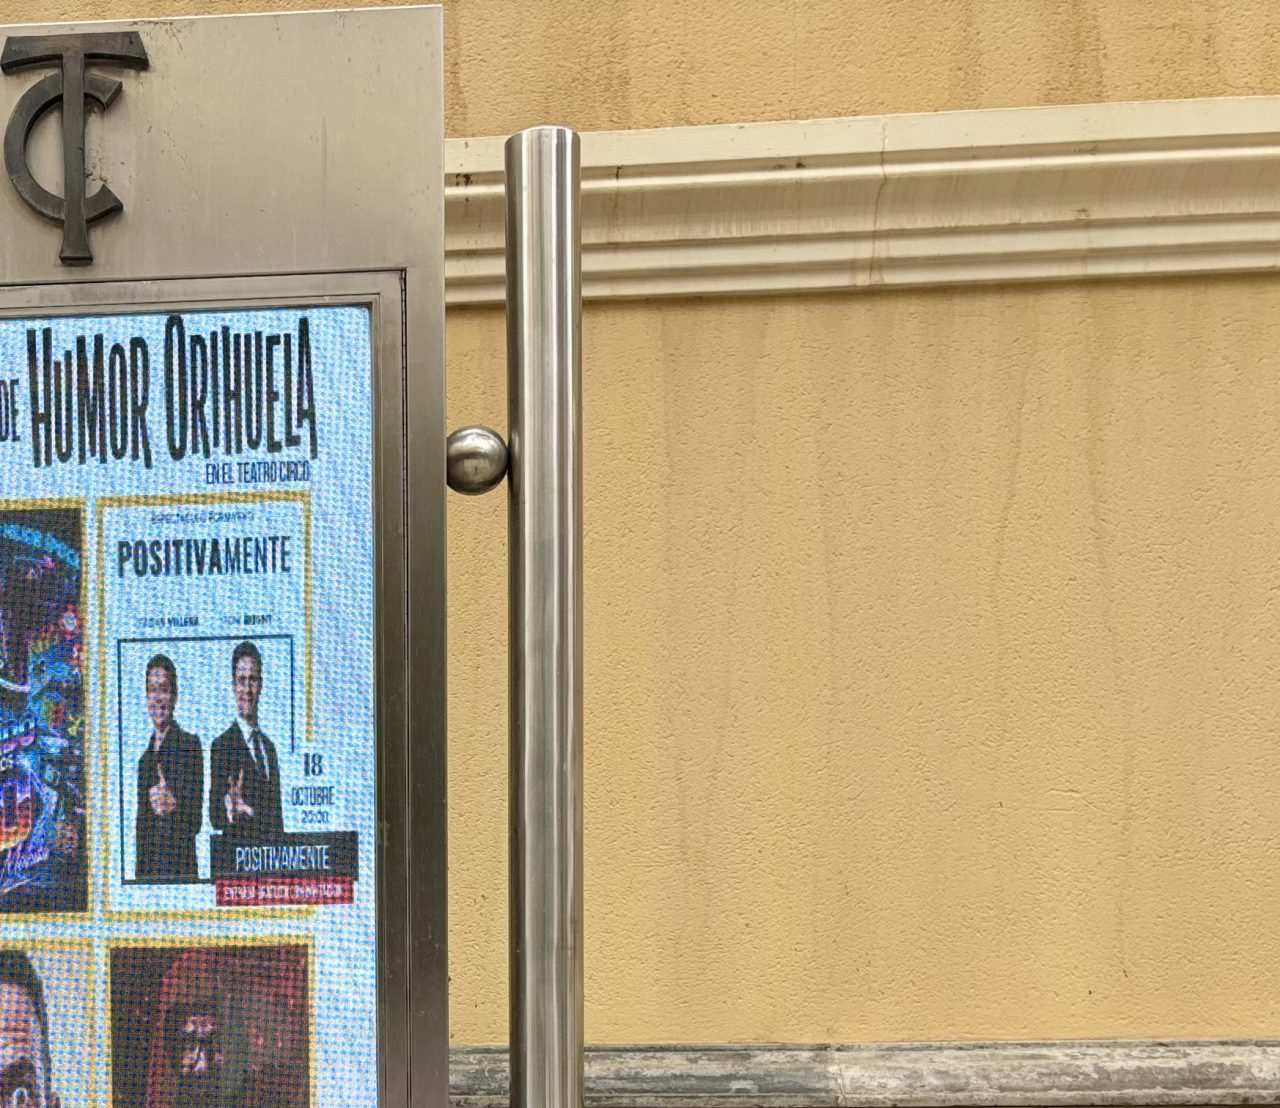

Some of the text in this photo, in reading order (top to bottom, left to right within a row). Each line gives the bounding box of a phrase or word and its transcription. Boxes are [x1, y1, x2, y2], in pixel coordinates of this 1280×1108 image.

[26, 327, 153, 470] HUMOR
[164, 315, 318, 461] ORIHUELA
[206, 460, 310, 484] EN EL TEATRO CIRCO
[117, 536, 290, 578] POSITIVAMENTE
[303, 752, 323, 777] 18
[291, 786, 335, 806] OCTUBRE
[236, 845, 331, 871] POSITIVAMENTE
